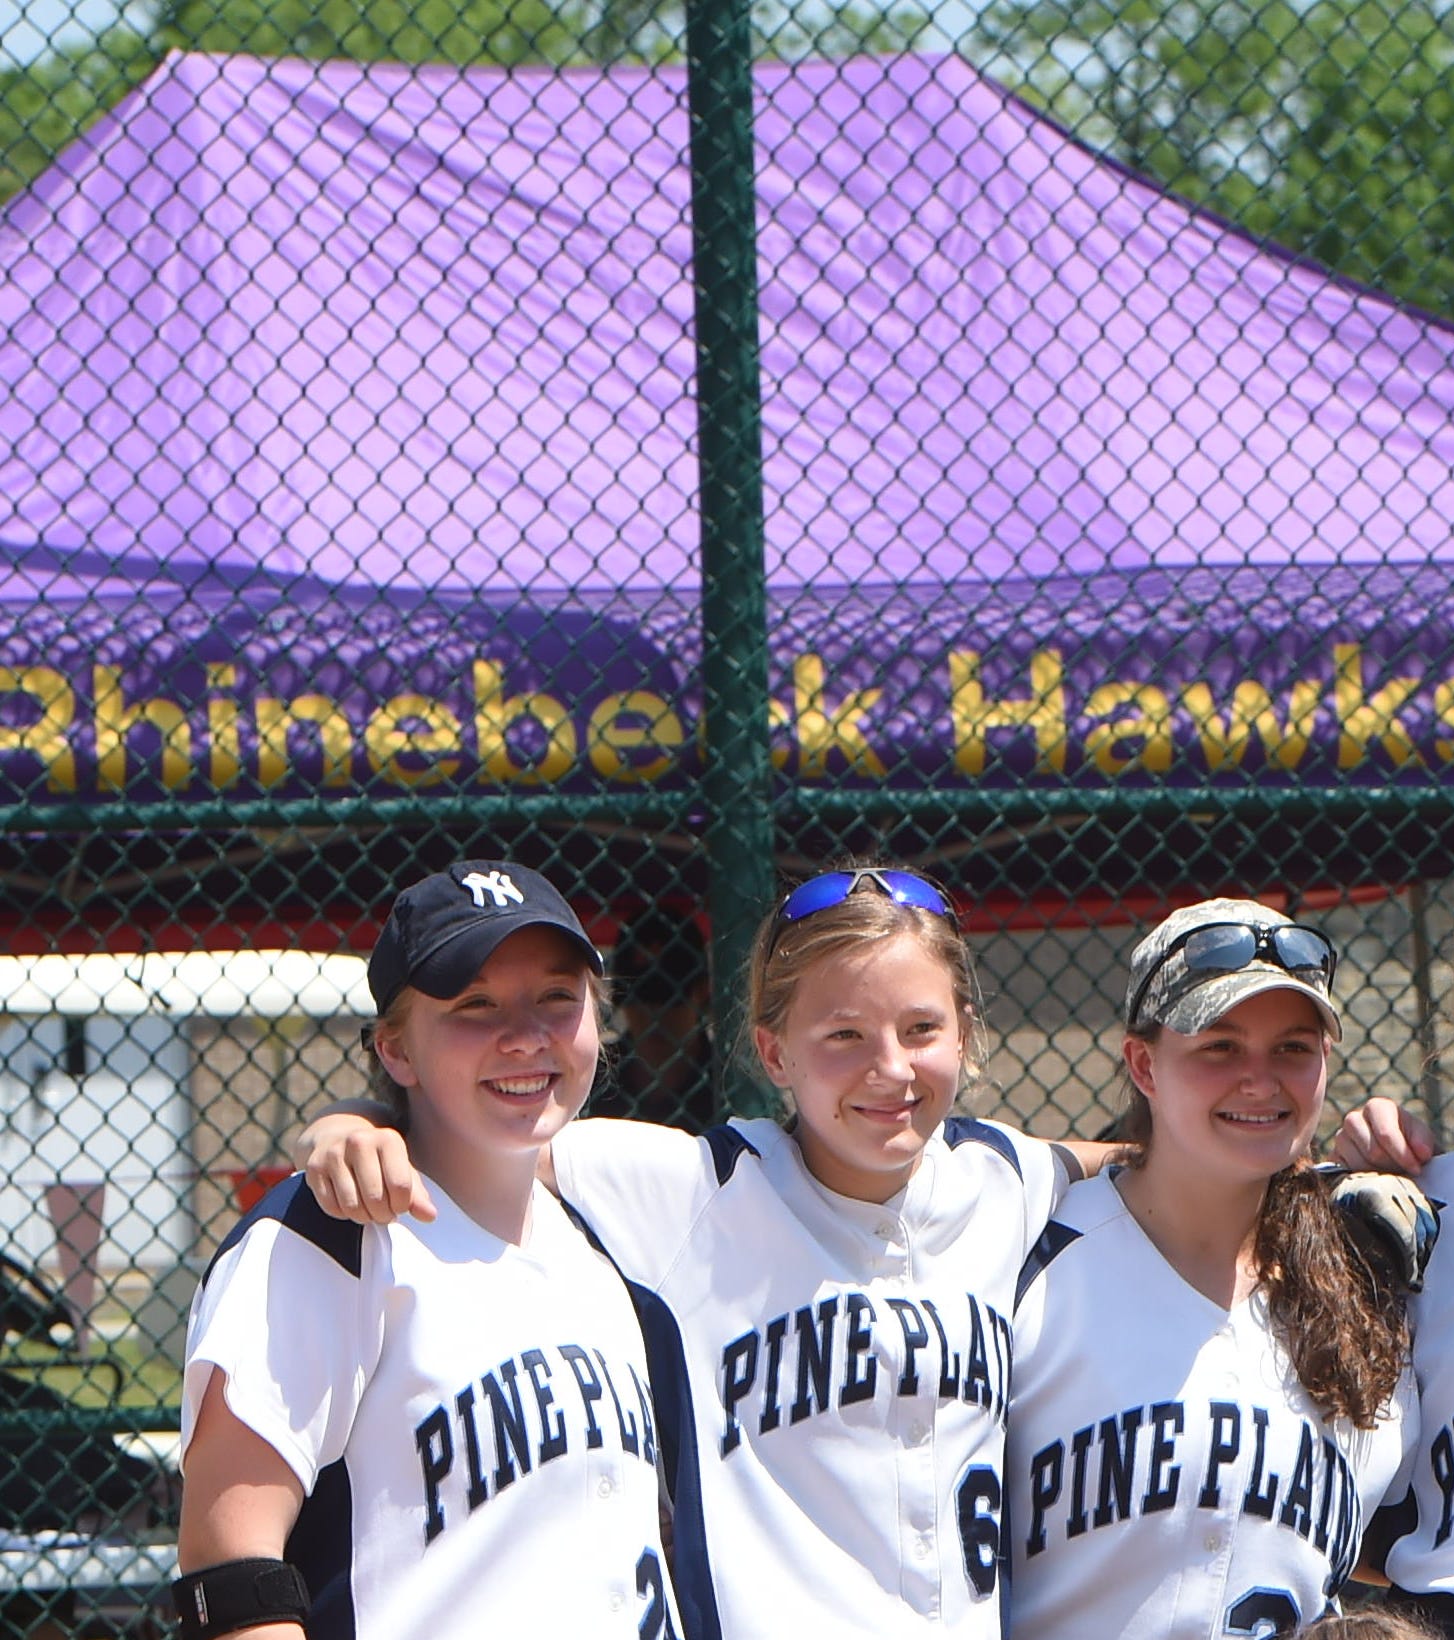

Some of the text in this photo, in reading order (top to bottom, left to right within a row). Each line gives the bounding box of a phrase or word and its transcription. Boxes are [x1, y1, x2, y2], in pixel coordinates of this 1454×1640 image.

[0, 652, 888, 792] Rhinebek
[415, 1348, 569, 1548] PINE
[720, 1292, 878, 1461] PINE
[953, 1462, 1000, 1604] 6
[1025, 1400, 1186, 1560] PINE
